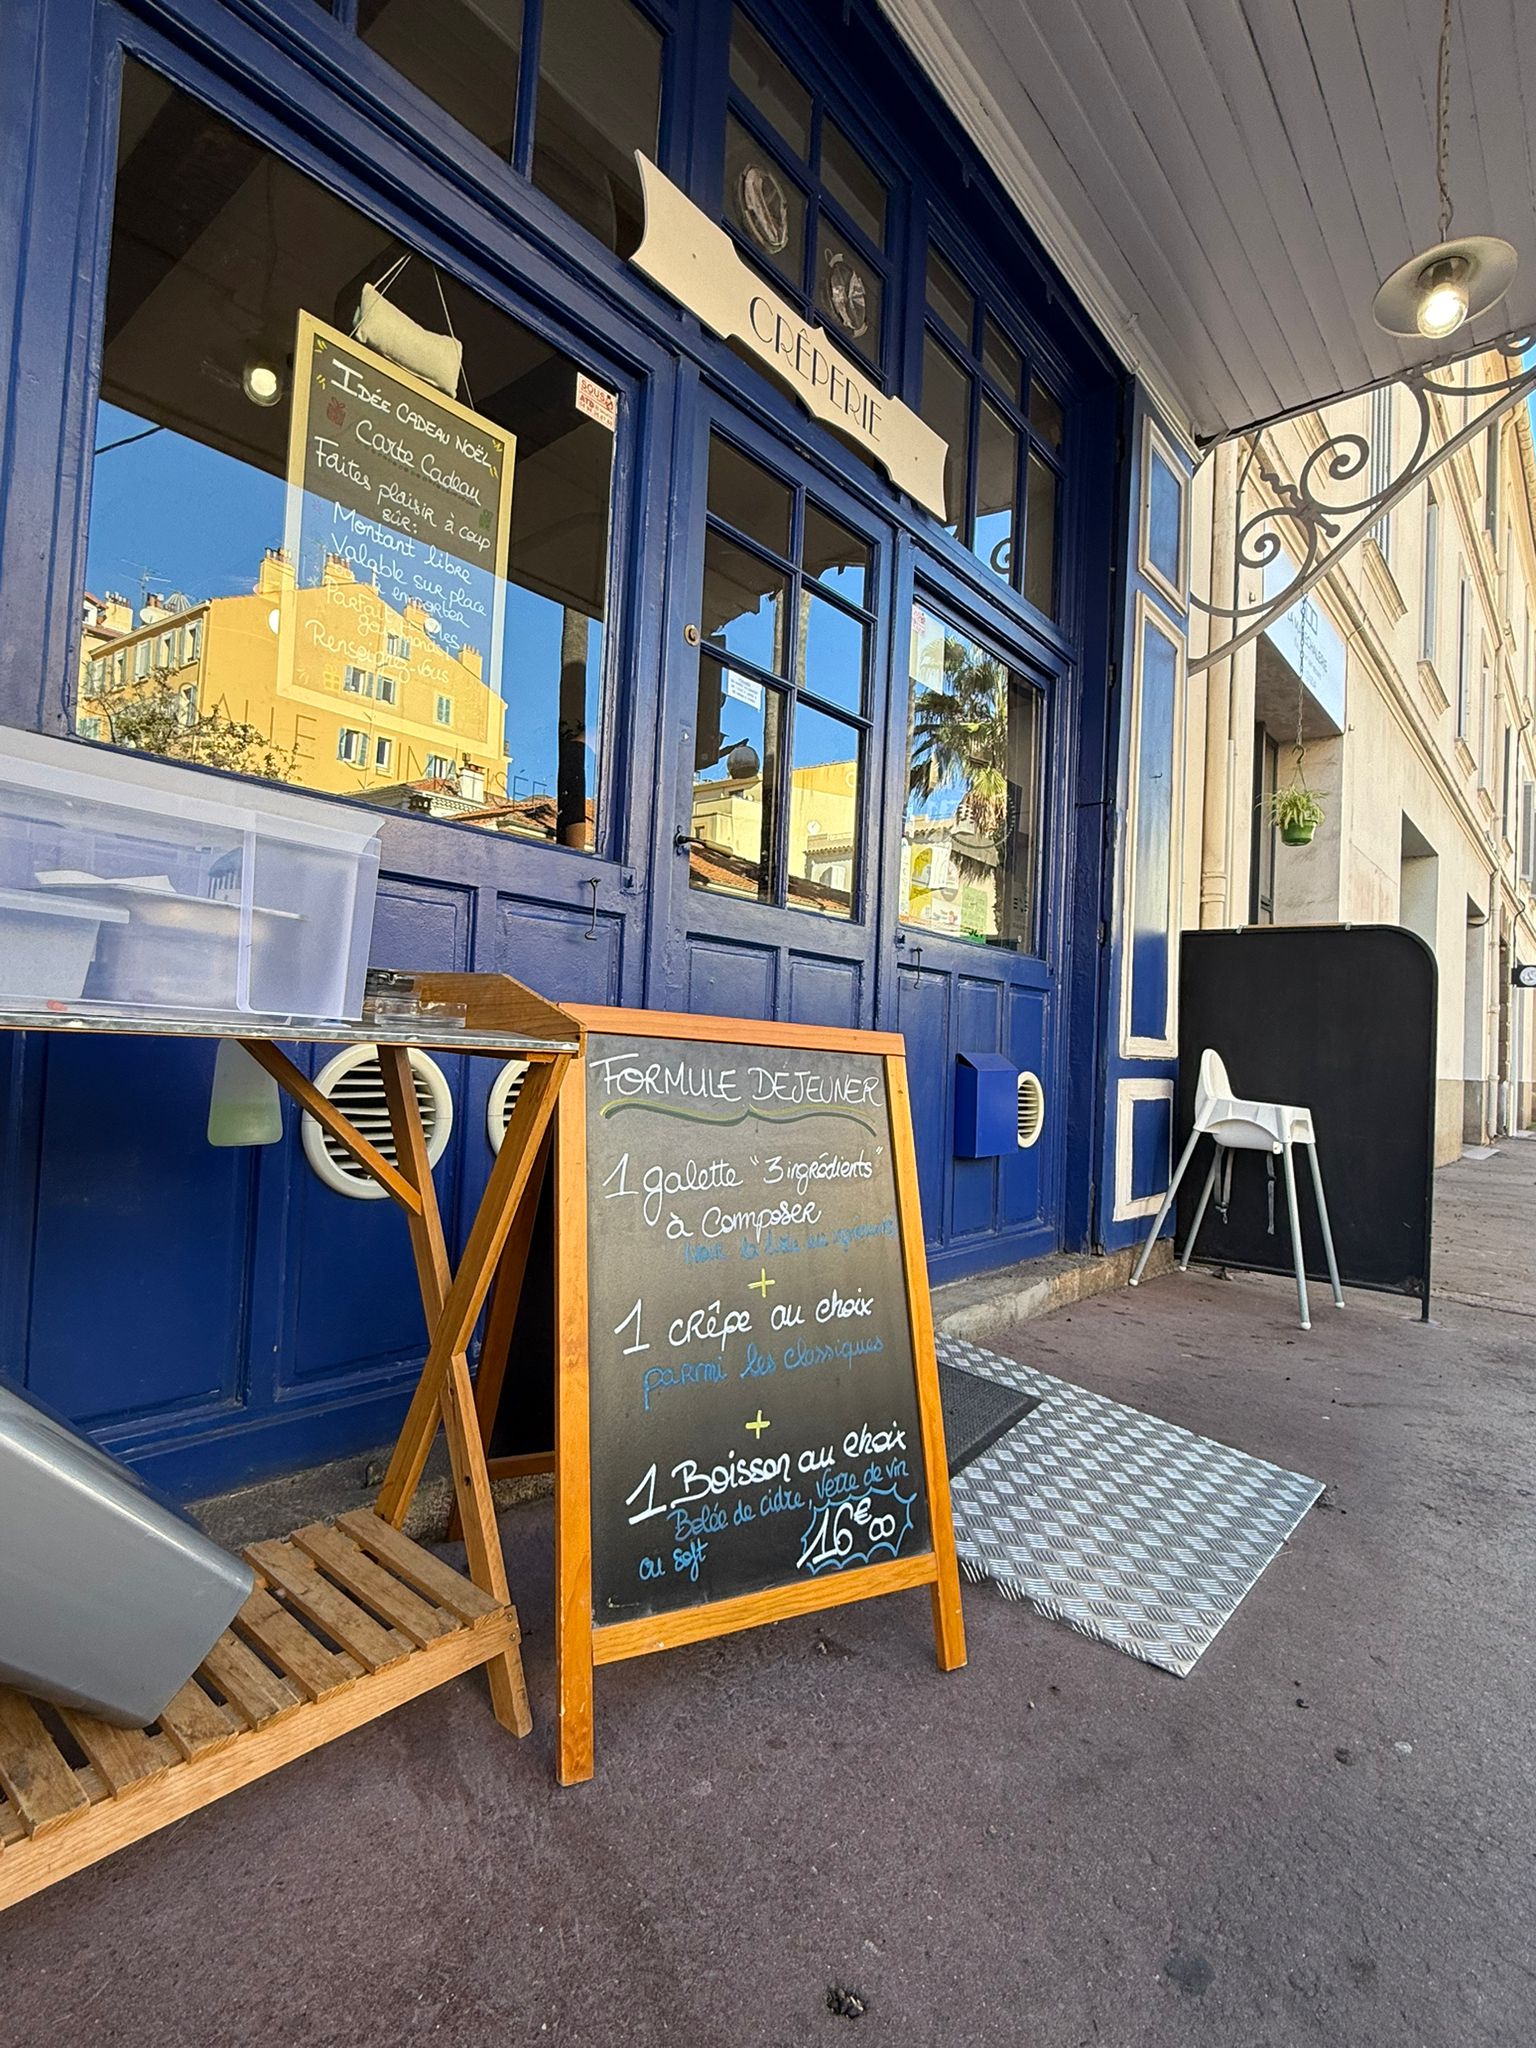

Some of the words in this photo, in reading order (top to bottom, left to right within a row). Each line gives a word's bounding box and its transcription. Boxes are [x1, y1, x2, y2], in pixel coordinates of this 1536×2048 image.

[749, 296, 883, 443] CRÊPERIE
[331, 358, 391, 413] IDÉE
[396, 403, 450, 445] CADEAU
[456, 435, 492, 468] NOËL
[315, 436, 371, 490] Faites
[377, 483, 437, 527] plaisir
[445, 512, 454, 535] à
[459, 526, 490, 552] coup
[356, 420, 414, 468] Carte
[421, 453, 481, 506] Cadeau
[331, 533, 408, 585] Valable
[414, 575, 447, 600] sur
[450, 588, 487, 617] place
[334, 502, 416, 557] Montant
[424, 545, 472, 584] libre
[589, 1053, 741, 1102] FORMULE
[602, 1153, 639, 1199] 1
[643, 1159, 744, 1226] galette
[666, 1212, 693, 1240] à
[614, 1298, 651, 1356] 1
[668, 1300, 752, 1352] crêpe
[771, 1303, 805, 1331] au
[815, 1288, 874, 1323] choix
[643, 1355, 728, 1411] parmi
[740, 1343, 777, 1380] les
[783, 1334, 885, 1371] classiques
[626, 1463, 667, 1526] 1
[670, 1449, 792, 1509] Boisson
[798, 1445, 836, 1473] au
[843, 1420, 907, 1458] choix
[733, 1499, 757, 1527] de
[863, 1461, 884, 1487] de
[886, 1456, 909, 1480] vin
[673, 1537, 709, 1583] soft
